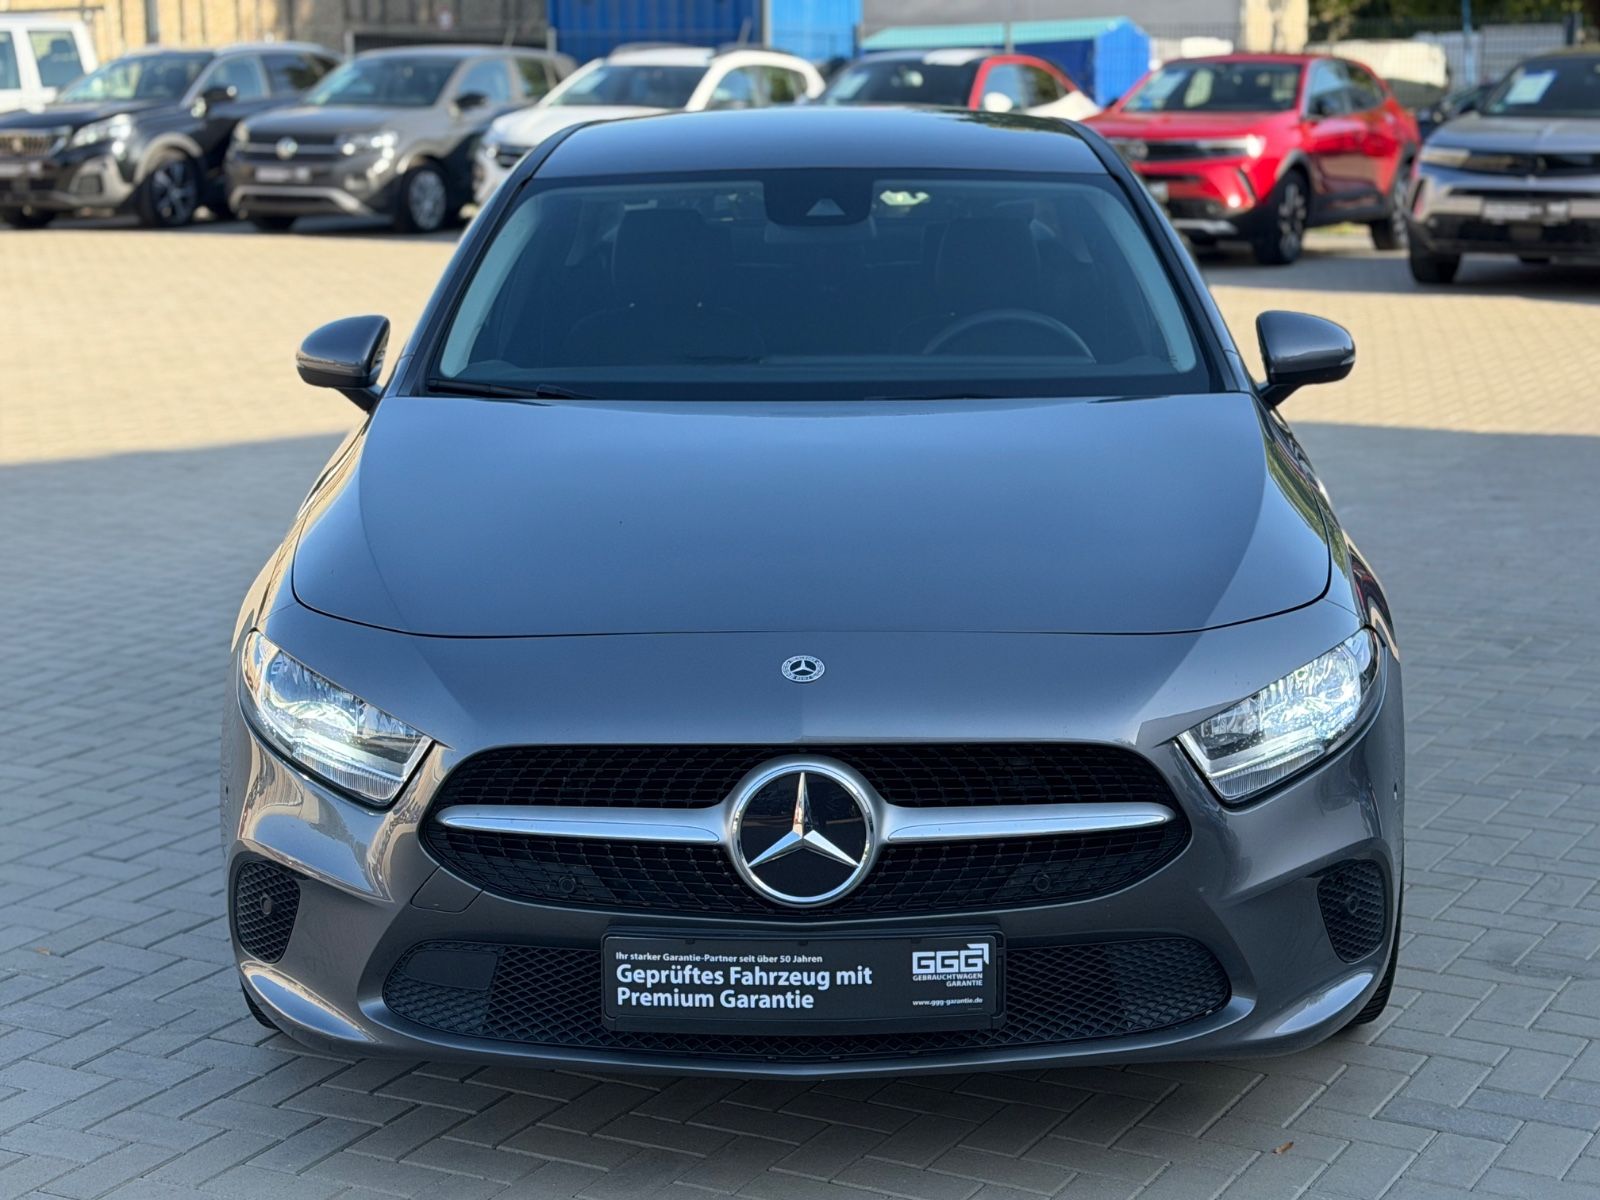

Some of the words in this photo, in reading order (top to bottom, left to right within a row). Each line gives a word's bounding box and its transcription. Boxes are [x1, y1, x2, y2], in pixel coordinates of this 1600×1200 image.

[615, 952, 629, 961] Ihr
[630, 952, 661, 961] starker
[662, 953, 737, 963] Garantie-Partner
[739, 954, 756, 963] seit
[756, 955, 778, 963] über
[779, 955, 791, 963] 50
[792, 955, 823, 963] Jahren
[912, 950, 983, 974] GGG
[616, 963, 725, 988] Geprüftes
[729, 965, 830, 991] Fahrzeug
[836, 965, 873, 986] mit
[912, 973, 983, 982] GEBRAUCHTWAGEN
[946, 980, 983, 988] GARANTIE
[617, 987, 715, 1008] Premium
[720, 989, 815, 1009] Garantie
[912, 997, 983, 1007] www.ggg-garantie.de
